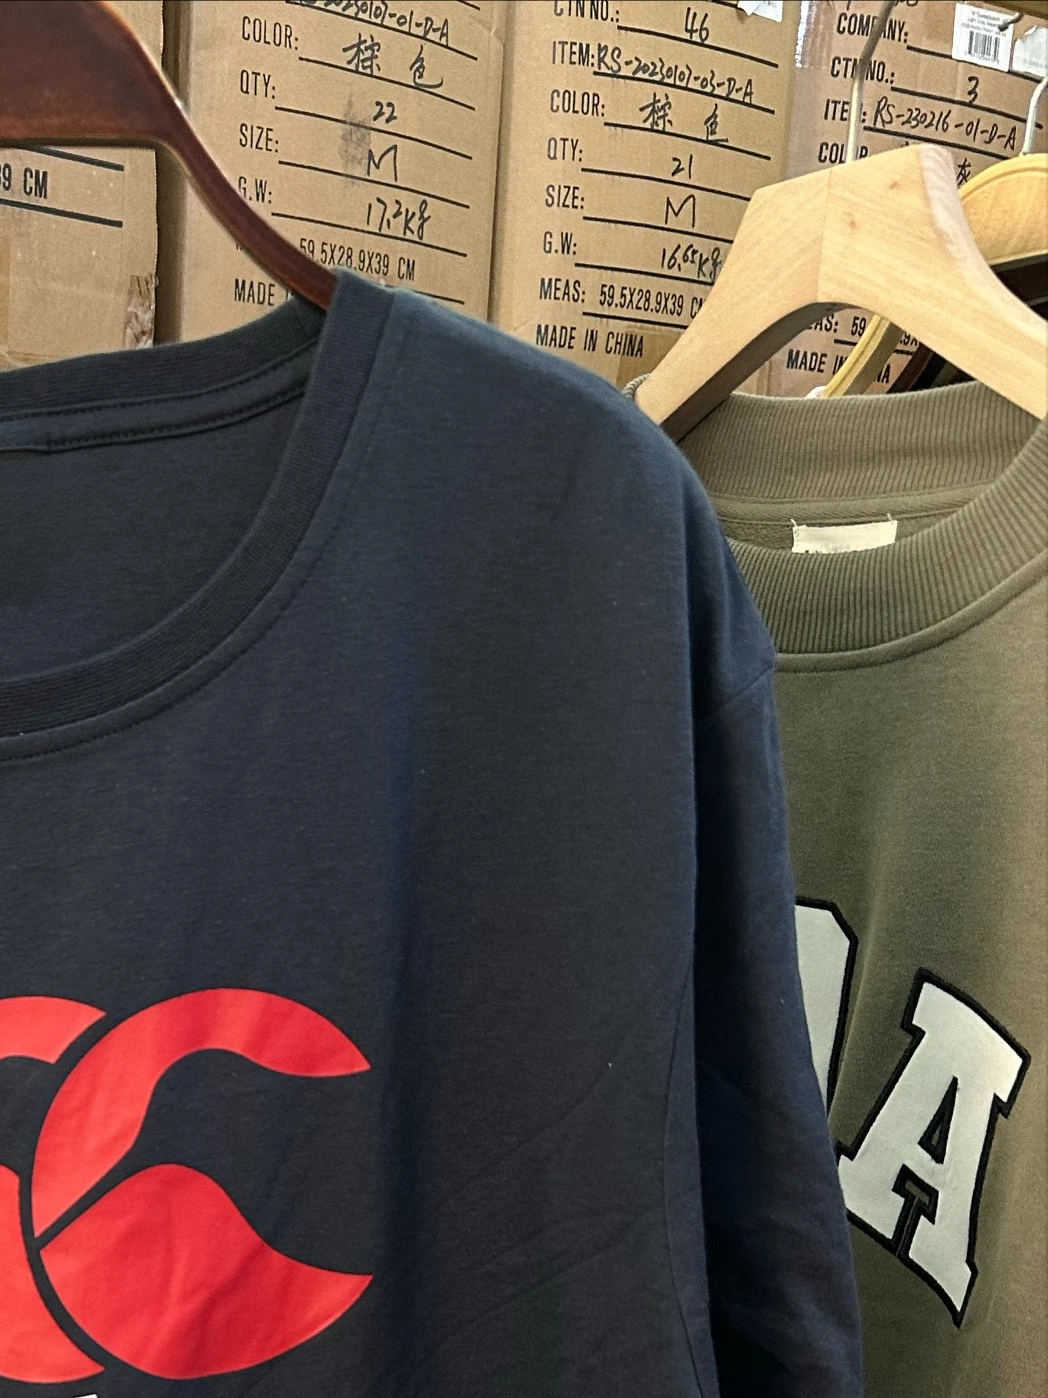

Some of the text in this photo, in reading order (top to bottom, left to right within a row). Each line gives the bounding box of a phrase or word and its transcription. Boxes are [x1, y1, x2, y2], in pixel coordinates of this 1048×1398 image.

[242, 16, 299, 50] COLOR:
[552, 41, 594, 67] ITEM:
[240, 69, 276, 99] QTY:
[372, 101, 398, 124] 22
[550, 89, 605, 118] COLOR:
[824, 98, 866, 123] ITE:
[239, 123, 279, 153] SIZE:
[547, 138, 583, 163] QTY:
[367, 144, 398, 183] M
[672, 155, 692, 179] 21
[23, 168, 48, 200] CM
[545, 185, 584, 210] SIZE:
[665, 194, 696, 228] M
[543, 231, 577, 256] G.W:
[397, 256, 416, 281] CM
[234, 278, 276, 306] MADE
[539, 278, 585, 303] MEAS:
[599, 283, 684, 317] 59.5X28.9X39
[536, 323, 644, 358] MADE IN CHINA
[786, 348, 828, 373] MADE
